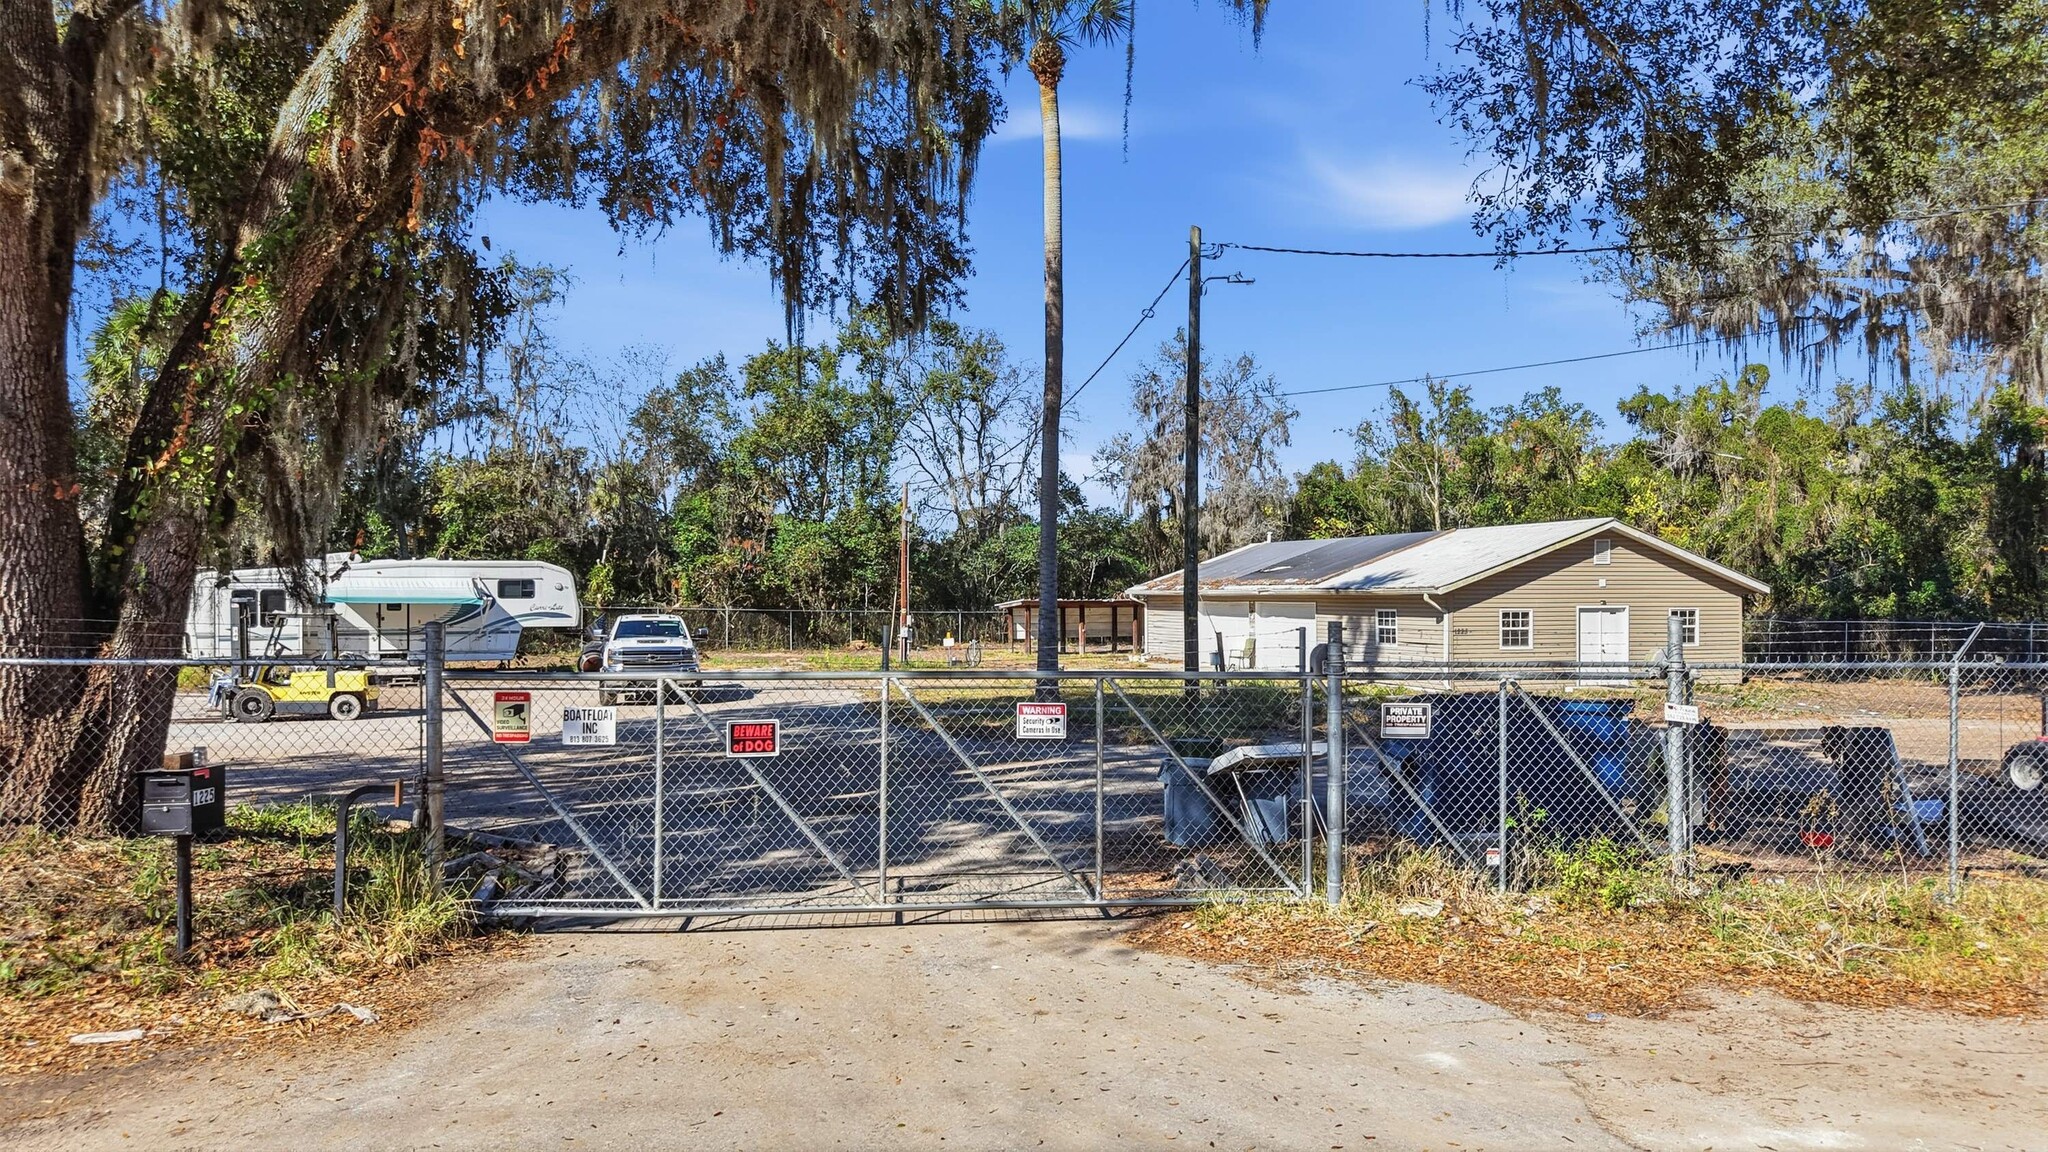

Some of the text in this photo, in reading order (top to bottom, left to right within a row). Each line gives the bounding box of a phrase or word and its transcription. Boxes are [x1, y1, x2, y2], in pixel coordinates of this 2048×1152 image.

[1022, 706, 1062, 715] WARNING
[1390, 707, 1422, 715] PRIVATE
[1022, 717, 1045, 726] Security
[1386, 715, 1426, 723] PROPERTY
[582, 722, 598, 734] INC
[734, 725, 773, 736] BEWARE
[1022, 726, 1045, 734] Cameras
[733, 739, 774, 752] of DOG
[194, 788, 215, 806] 1225
